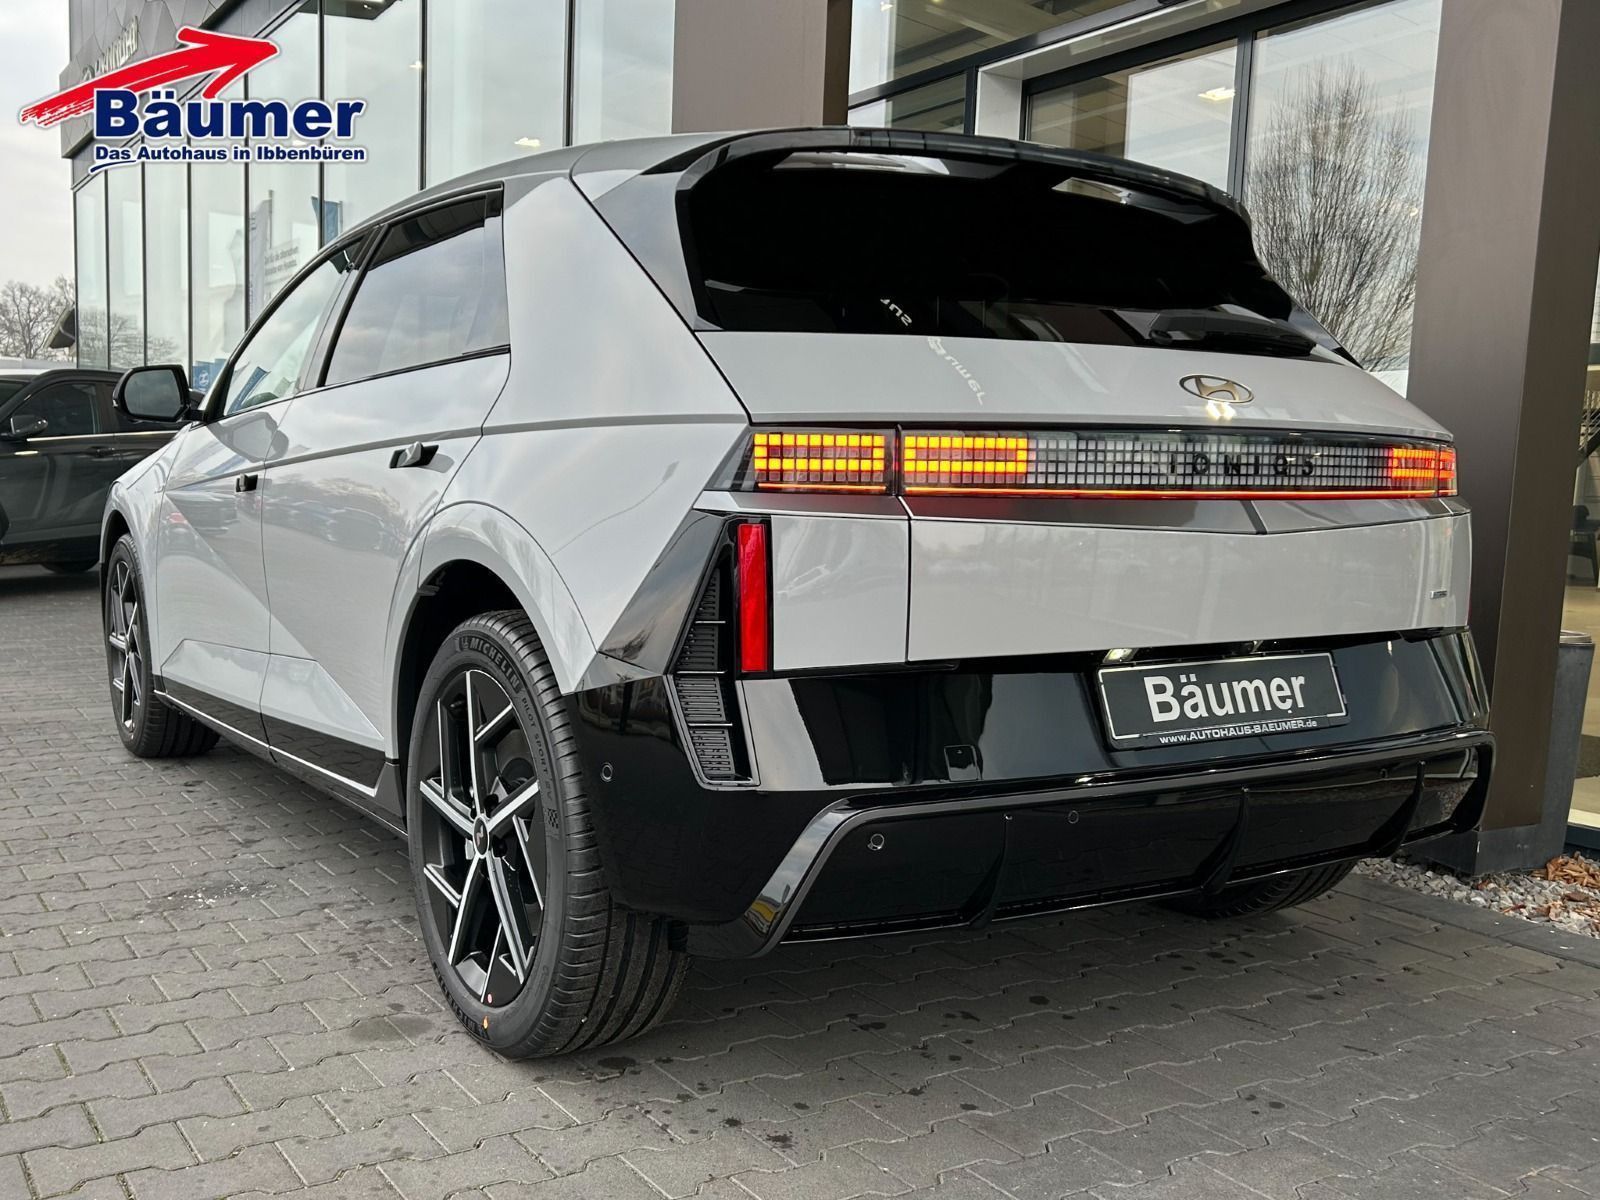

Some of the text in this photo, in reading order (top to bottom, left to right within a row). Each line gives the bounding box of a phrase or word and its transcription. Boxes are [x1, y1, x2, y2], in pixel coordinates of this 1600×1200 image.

[470, 637, 520, 690] MICHELIN
[522, 697, 536, 728] PILOT
[534, 733, 548, 774] SPORT
[1143, 673, 1306, 723] Bäumer
[1159, 718, 1318, 744] www.AUTOHAUS-BAEUMER.de
